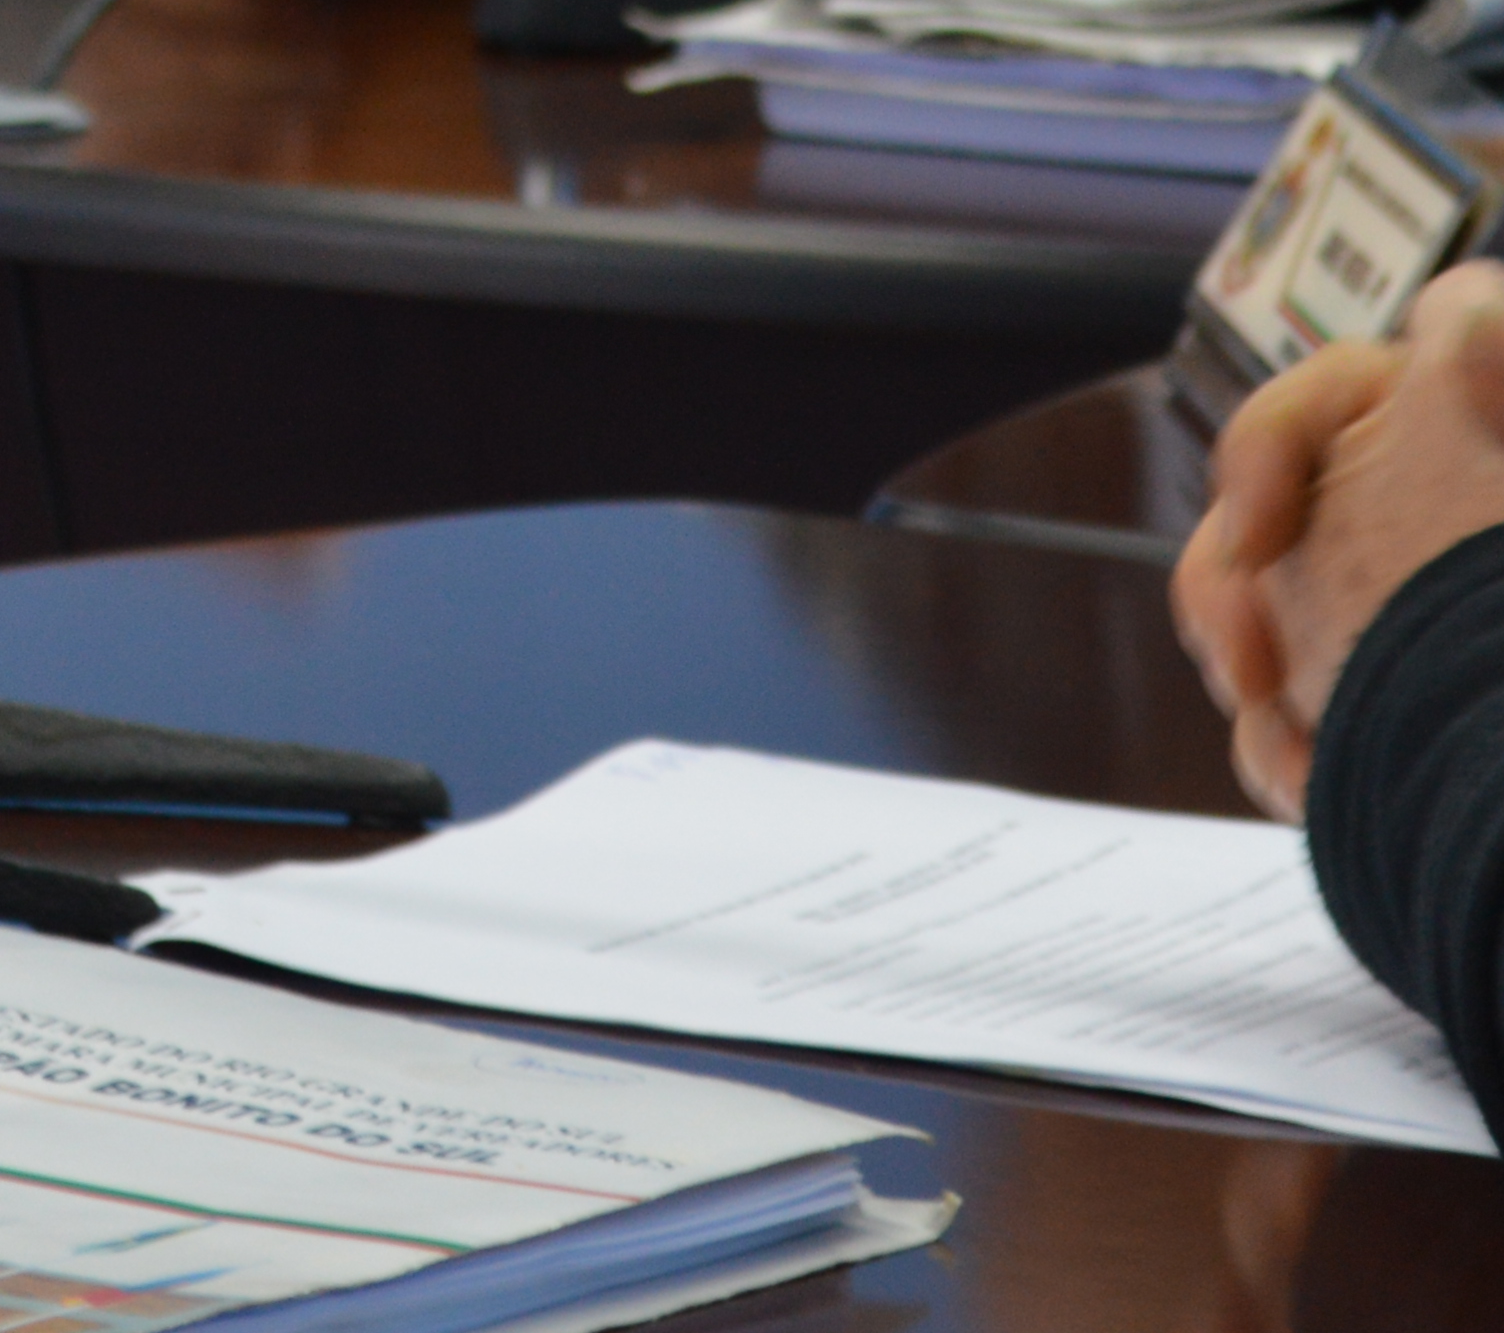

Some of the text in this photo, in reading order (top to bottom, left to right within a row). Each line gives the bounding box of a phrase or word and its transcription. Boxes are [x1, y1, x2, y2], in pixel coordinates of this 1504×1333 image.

[91, 1078, 301, 1127] BONITO
[306, 1122, 392, 1147] DO
[396, 1140, 500, 1166] SUL
[129, 1056, 335, 1110] MUNICIPAL
[345, 1108, 396, 1126] DE
[416, 1122, 677, 1170] VEREADORES
[148, 1043, 213, 1064] DO
[219, 1057, 295, 1083] RIO
[298, 1077, 468, 1121] GRANDE
[481, 1114, 546, 1130] DO
[557, 1124, 625, 1144] SUL
